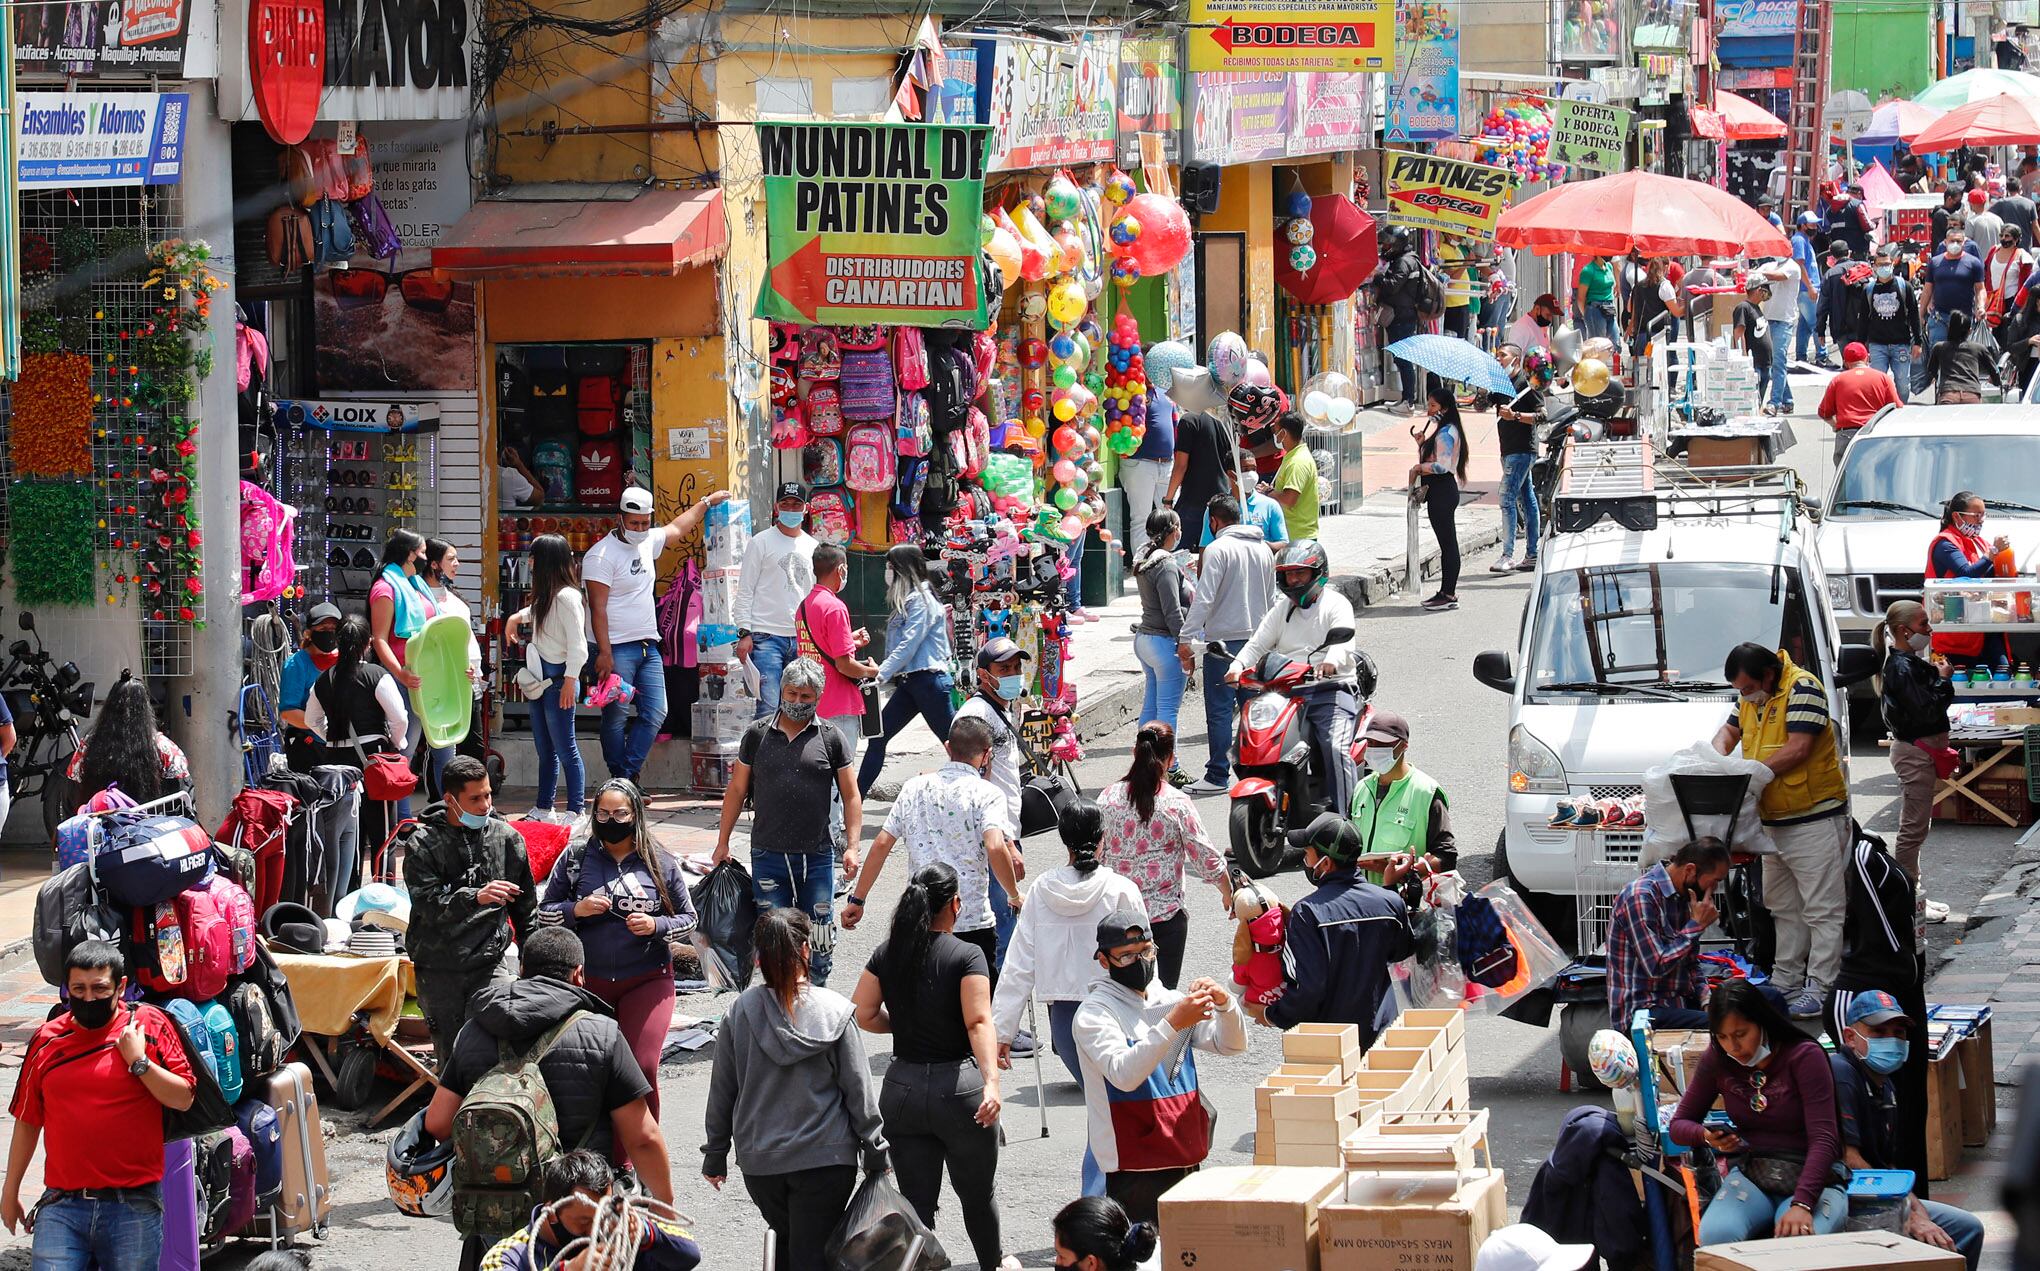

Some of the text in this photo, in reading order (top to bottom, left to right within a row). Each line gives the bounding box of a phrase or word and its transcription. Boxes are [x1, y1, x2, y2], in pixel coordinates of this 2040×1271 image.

[1206, 3, 1378, 11] MANEJAMOS PRECIOS ESPECIALES PARA MAYORISTAS
[326, 0, 468, 89] MAYOR
[1232, 26, 1360, 44] BODEGA
[54, 45, 96, 61] Accesorios
[101, 45, 139, 65] Maquillaje
[140, 47, 182, 62] Profesional
[1420, 47, 1442, 57] SOMOS
[1223, 57, 1334, 67] RECIBIMOS TODAS LAS TARJETAS
[1123, 77, 1151, 115] LATINO
[22, 102, 146, 135] Ensambles Y Adornos
[1021, 106, 1109, 138] Distribuidores Mayoristas
[1409, 114, 1455, 127] BODEGA 215
[1572, 104, 1615, 121] OFERTA
[1563, 117, 1619, 136] Y BODEGA
[1556, 131, 1622, 151] DE PATINES
[760, 126, 986, 181] MUNDIAL DE
[383, 164, 399, 173] que
[402, 159, 436, 171] mirarla
[382, 179, 393, 190] de
[396, 178, 409, 190] las
[412, 178, 437, 193] gafas
[1391, 156, 1506, 197] PATINES
[796, 181, 949, 236] PATINES
[1412, 192, 1484, 217] BODEGA
[825, 257, 965, 279] DISTRIBUIDORES
[825, 278, 963, 306] CANARIAN
[333, 407, 376, 423] LOIX
[580, 486, 611, 496] adidas
[180, 852, 206, 874] HILFIGER
[1399, 1254, 1412, 1264] KG
[1416, 1254, 1430, 1264] 8.8
